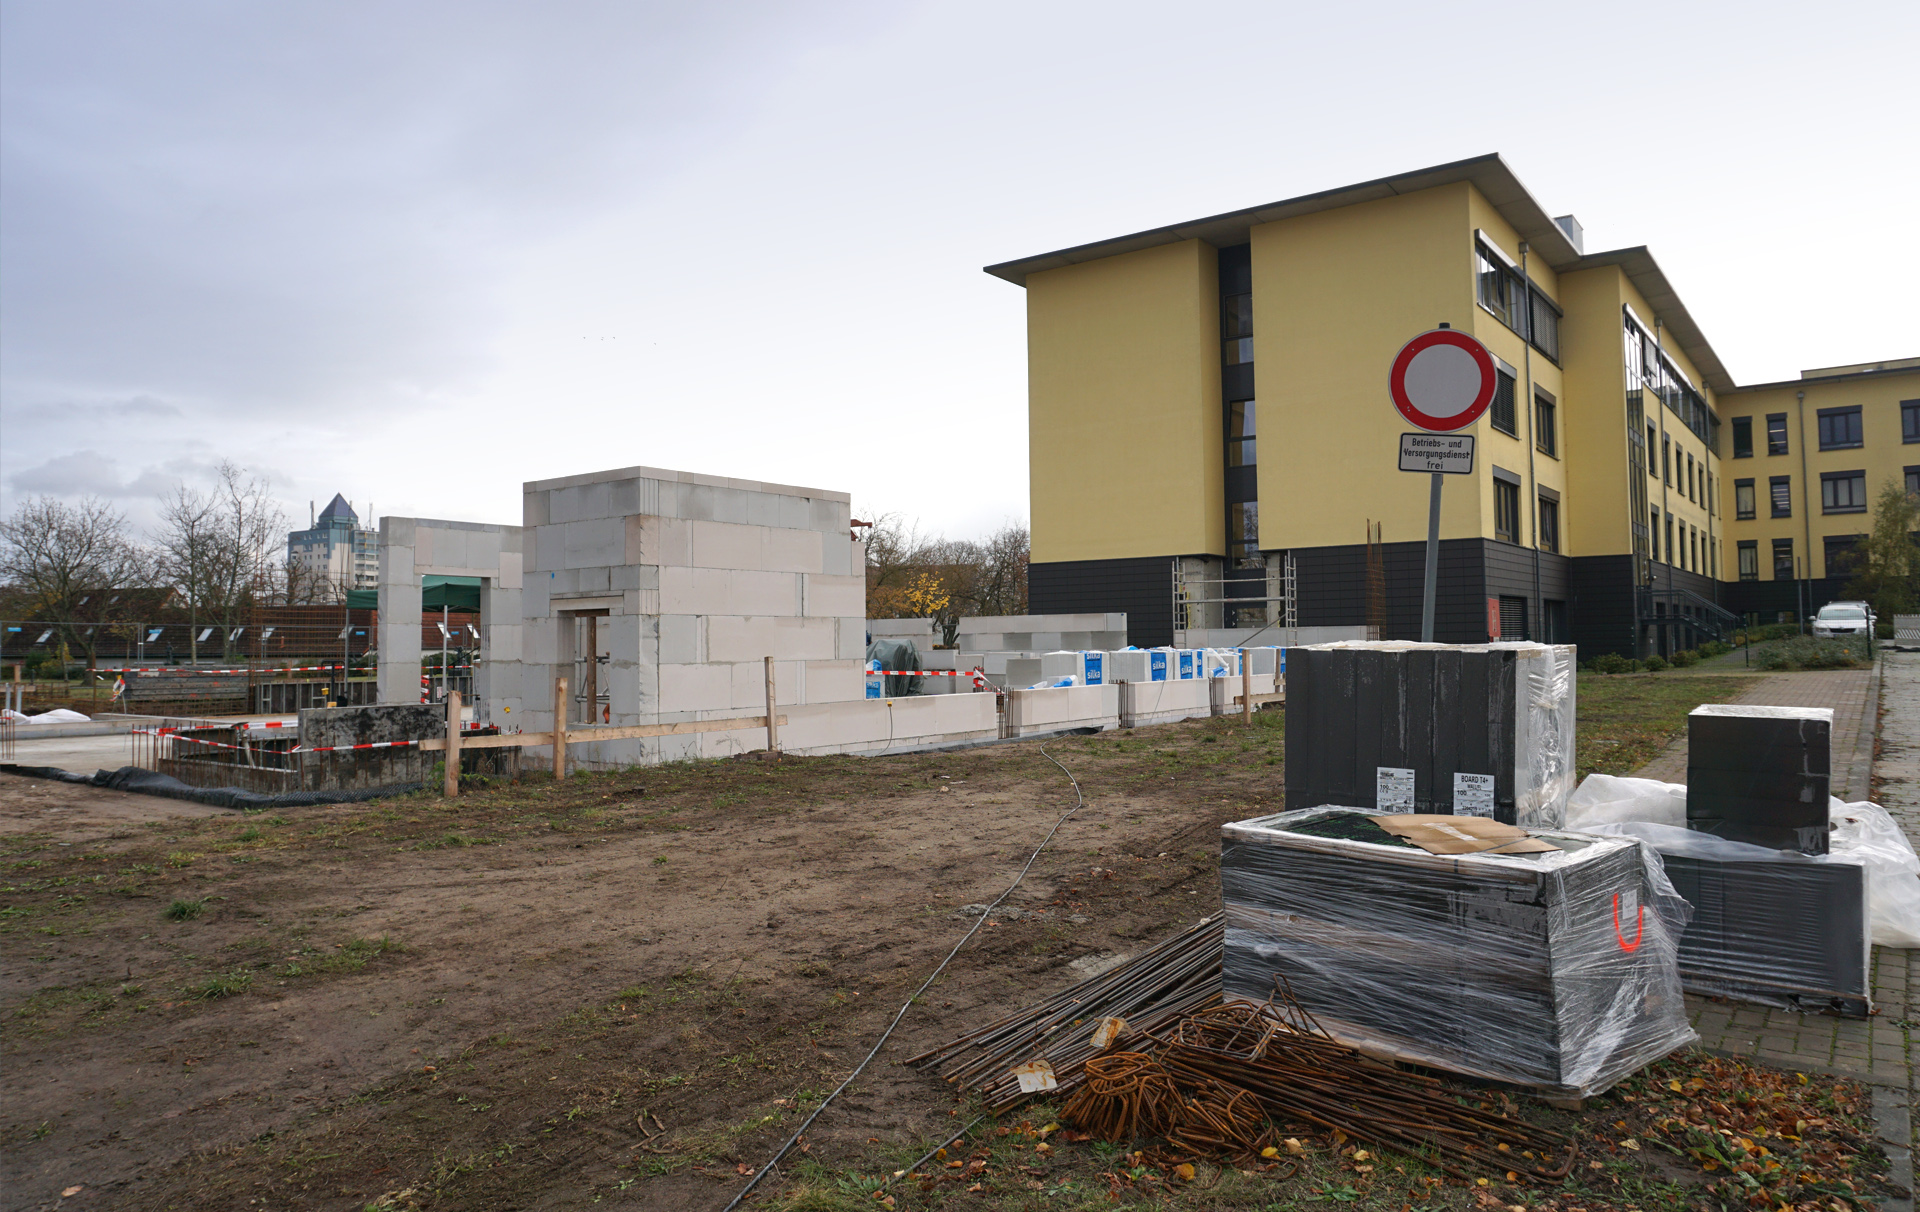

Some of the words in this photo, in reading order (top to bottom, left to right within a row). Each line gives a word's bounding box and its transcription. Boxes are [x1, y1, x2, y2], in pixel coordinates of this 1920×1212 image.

[1412, 438, 1445, 447] Betriebs-
[1449, 440, 1462, 448] und
[1403, 448, 1470, 459] Versorgungsdienst
[1427, 461, 1443, 469] frei
[1152, 660, 1165, 669] silka
[1087, 669, 1100, 679] silka
[1461, 775, 1479, 783] BOARD
[1479, 776, 1488, 784] T4+
